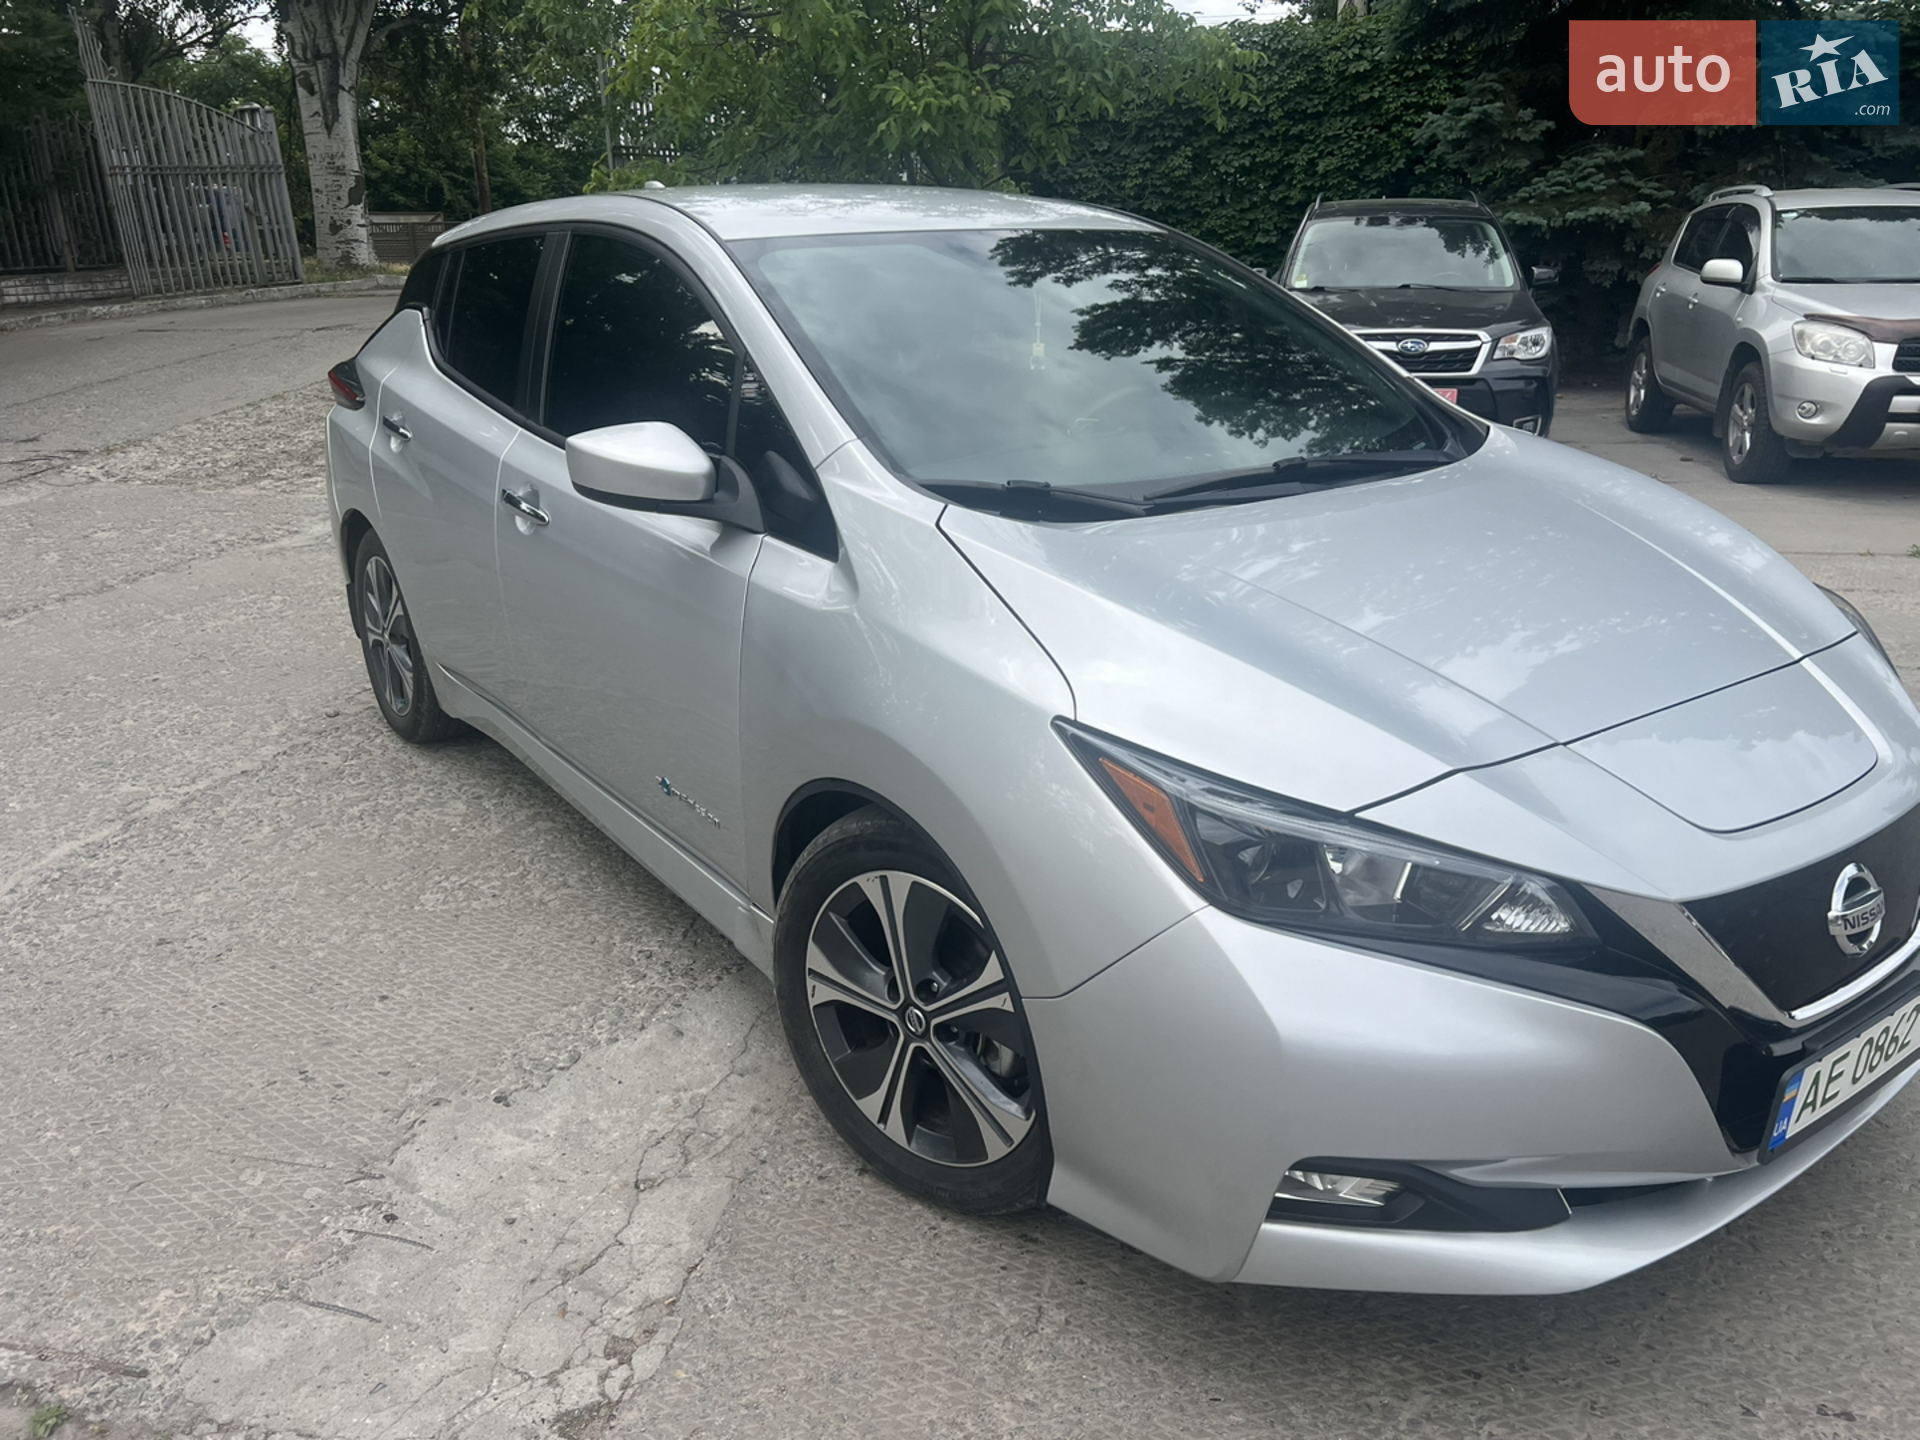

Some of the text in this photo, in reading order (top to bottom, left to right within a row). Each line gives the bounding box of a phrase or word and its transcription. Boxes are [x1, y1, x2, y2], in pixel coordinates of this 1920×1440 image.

[1843, 900, 1885, 931] NISSA
[1795, 1003, 1920, 1124] AE 0862
